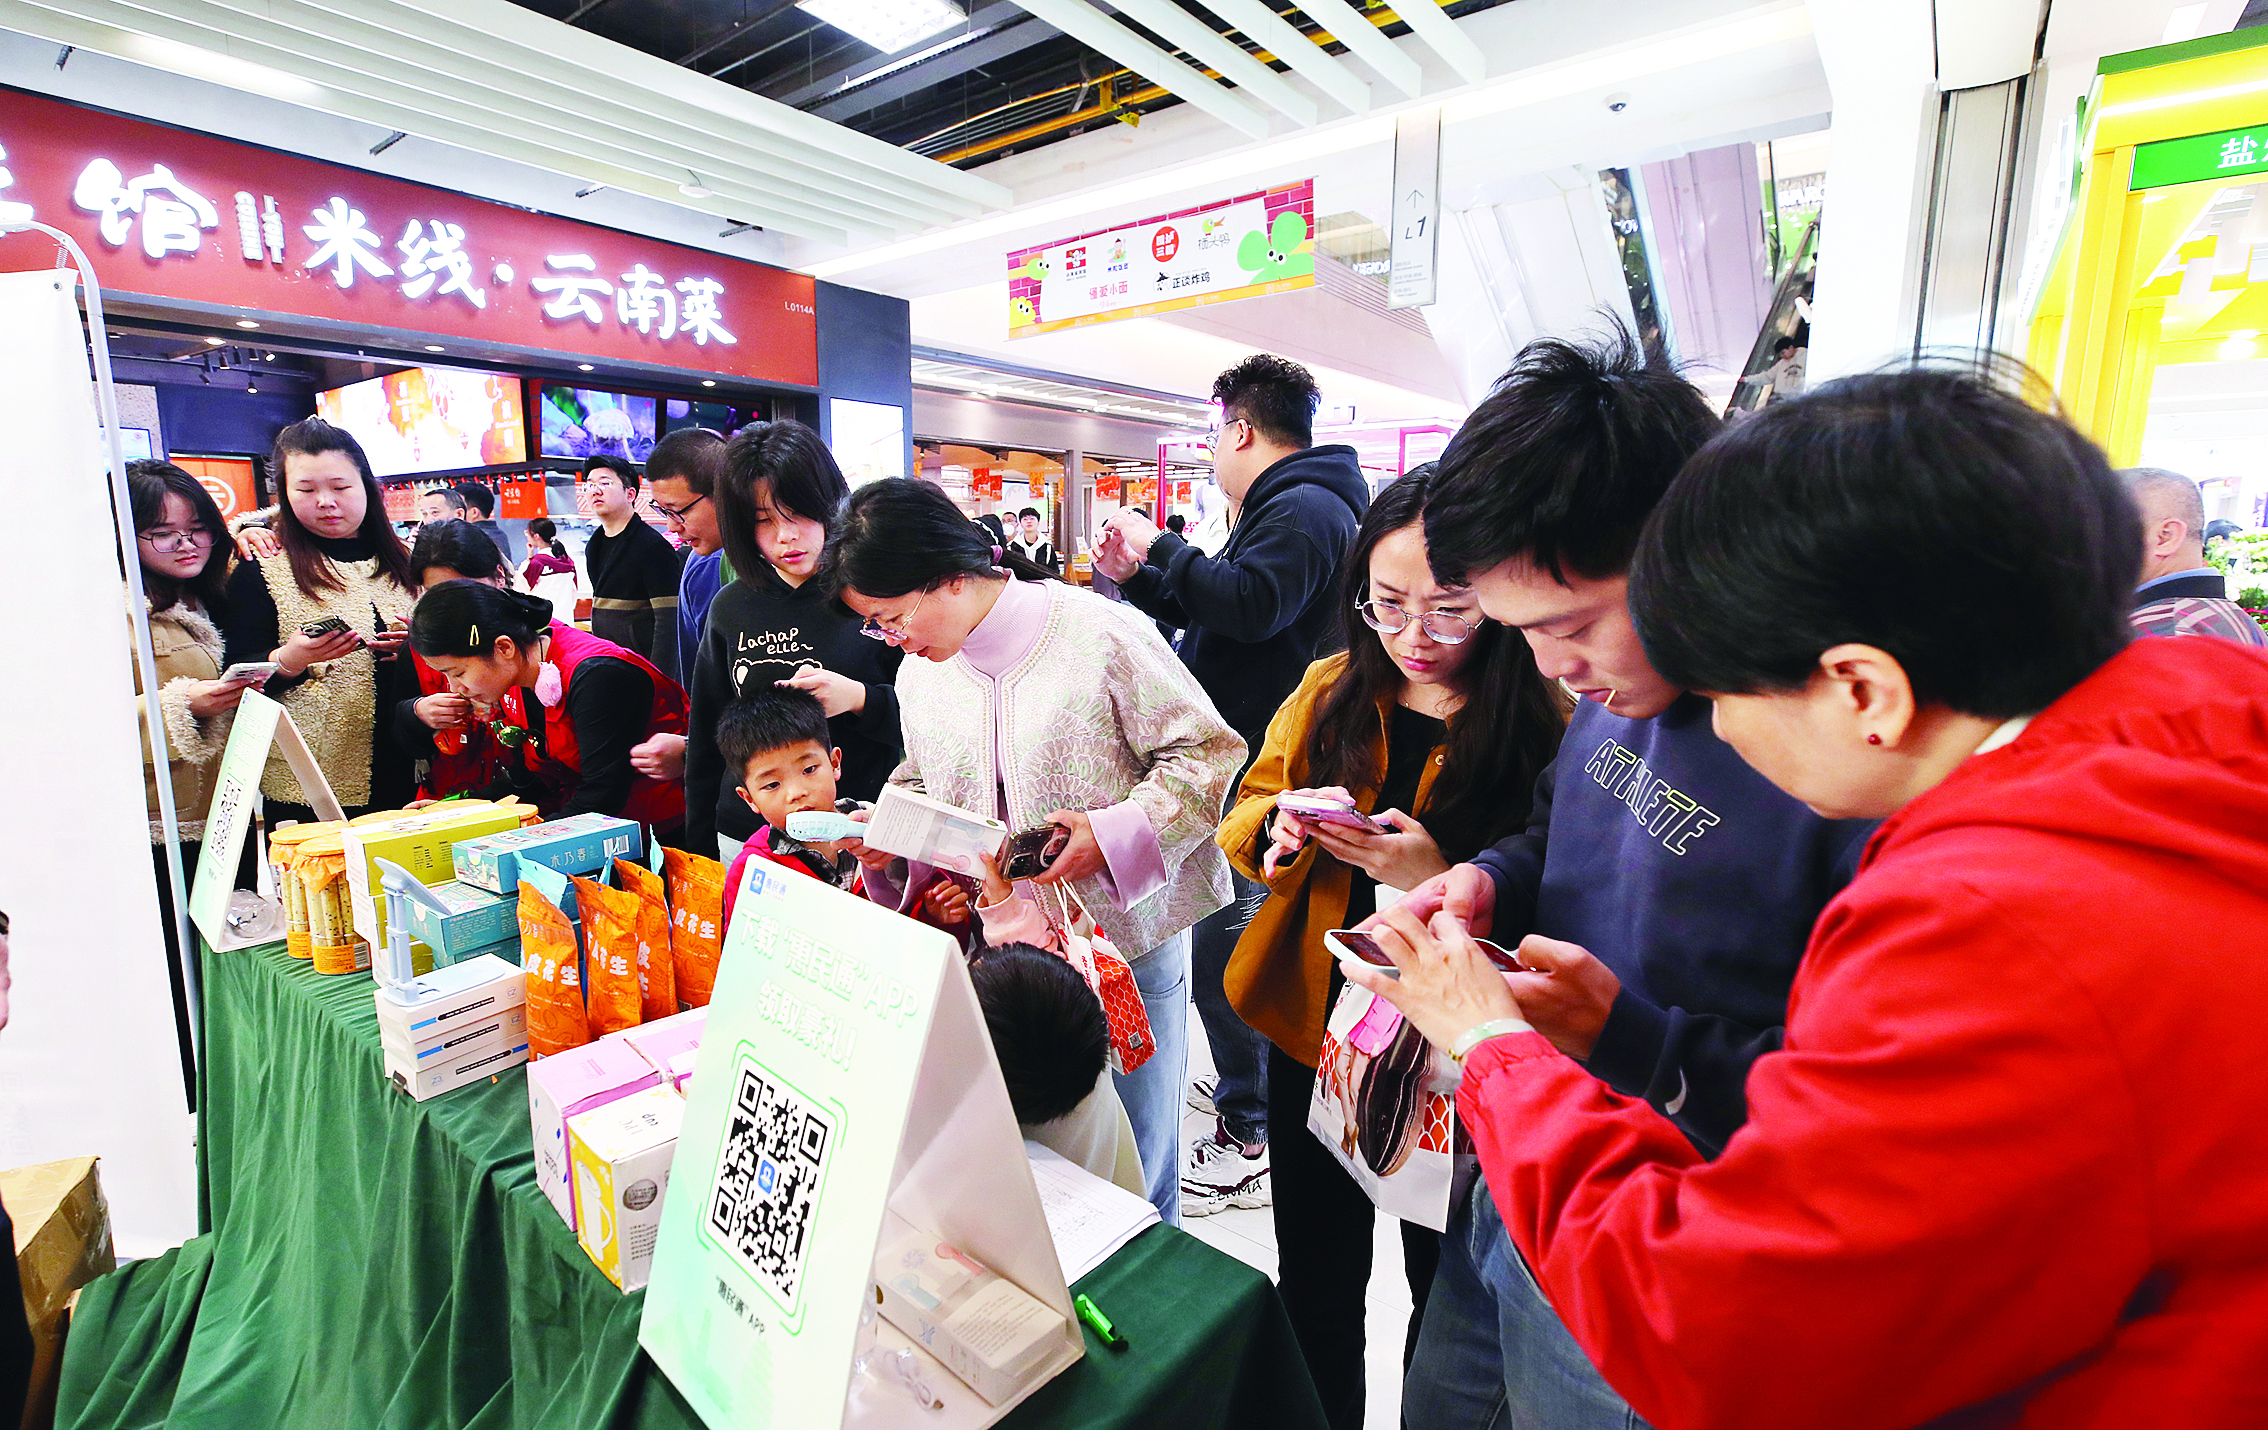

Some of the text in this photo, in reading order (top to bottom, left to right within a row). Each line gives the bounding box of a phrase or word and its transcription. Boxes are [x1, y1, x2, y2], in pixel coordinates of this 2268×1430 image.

[2217, 135, 2268, 169] 盐
[784, 301, 814, 315] L0114A
[737, 627, 799, 651] Lachap
